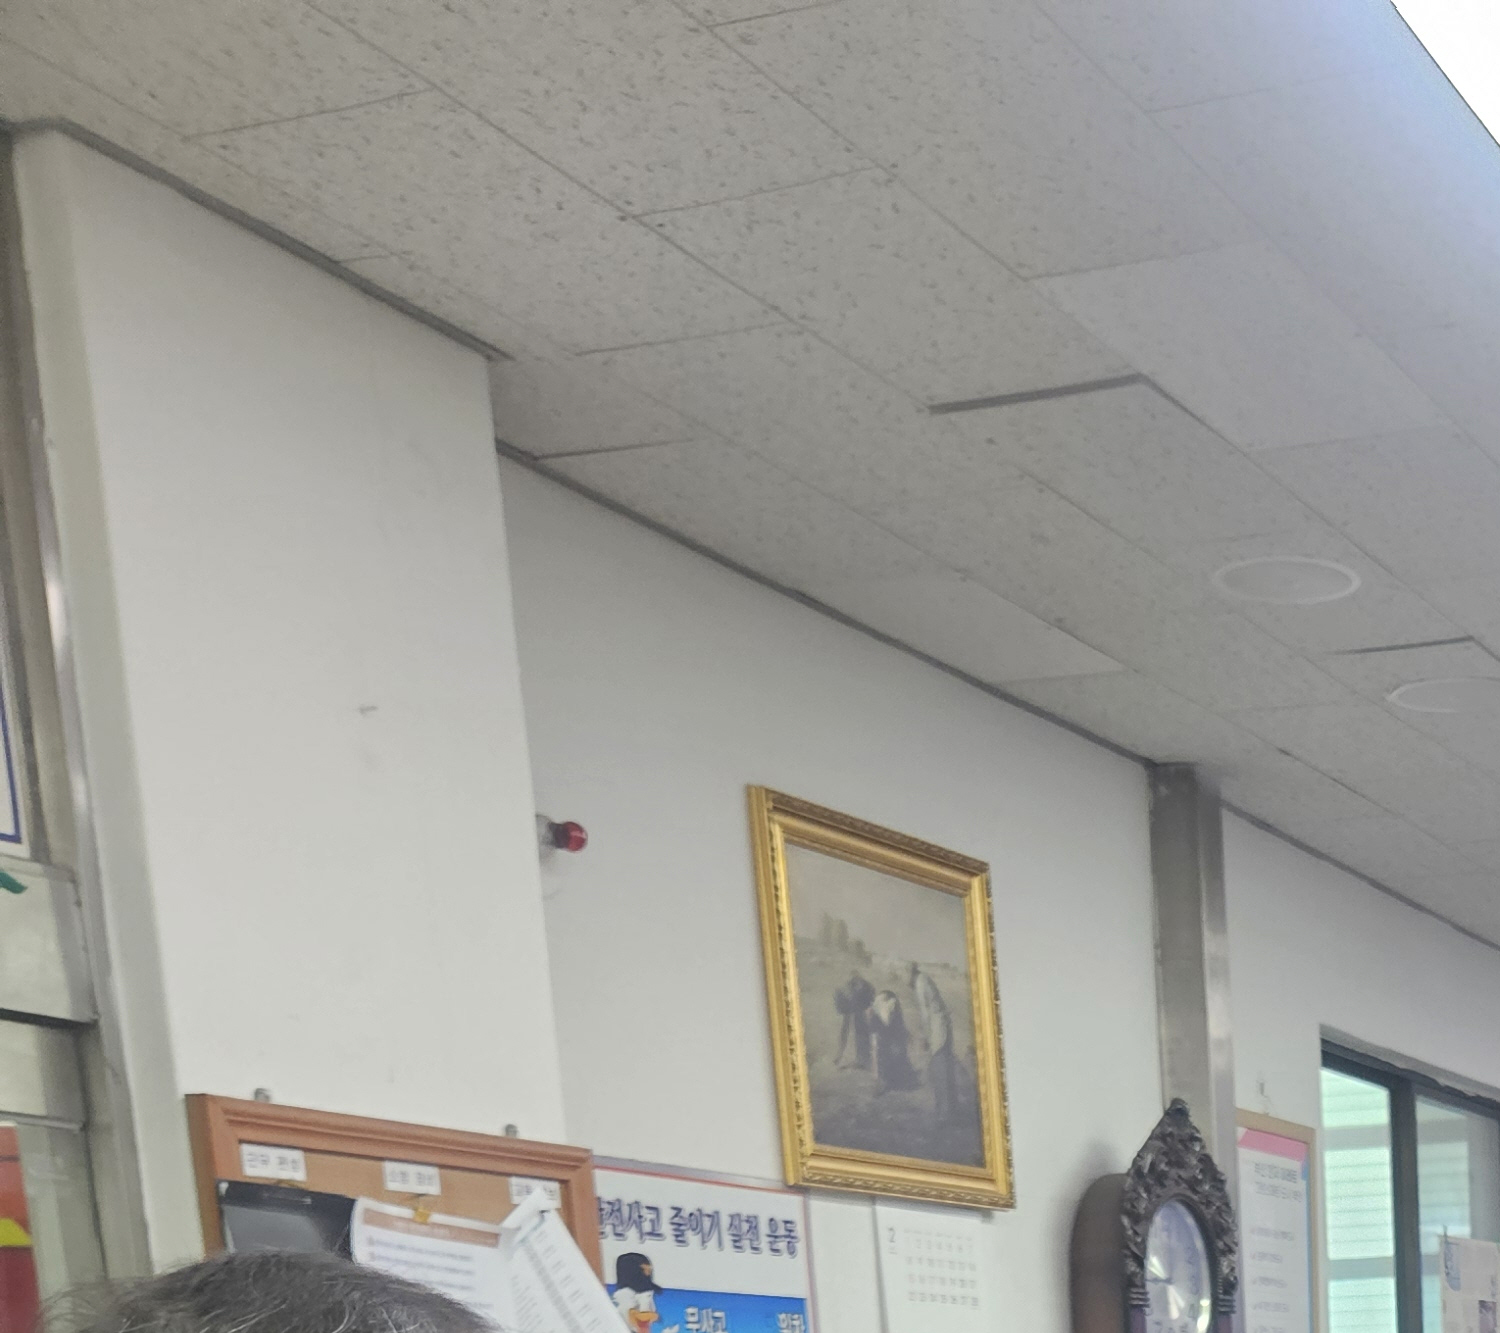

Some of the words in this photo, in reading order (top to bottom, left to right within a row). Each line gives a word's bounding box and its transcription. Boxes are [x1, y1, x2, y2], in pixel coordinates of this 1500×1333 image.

[670, 1205, 723, 1251] 줄이기
[728, 1213, 762, 1253] 실천
[766, 1218, 801, 1258] 운동
